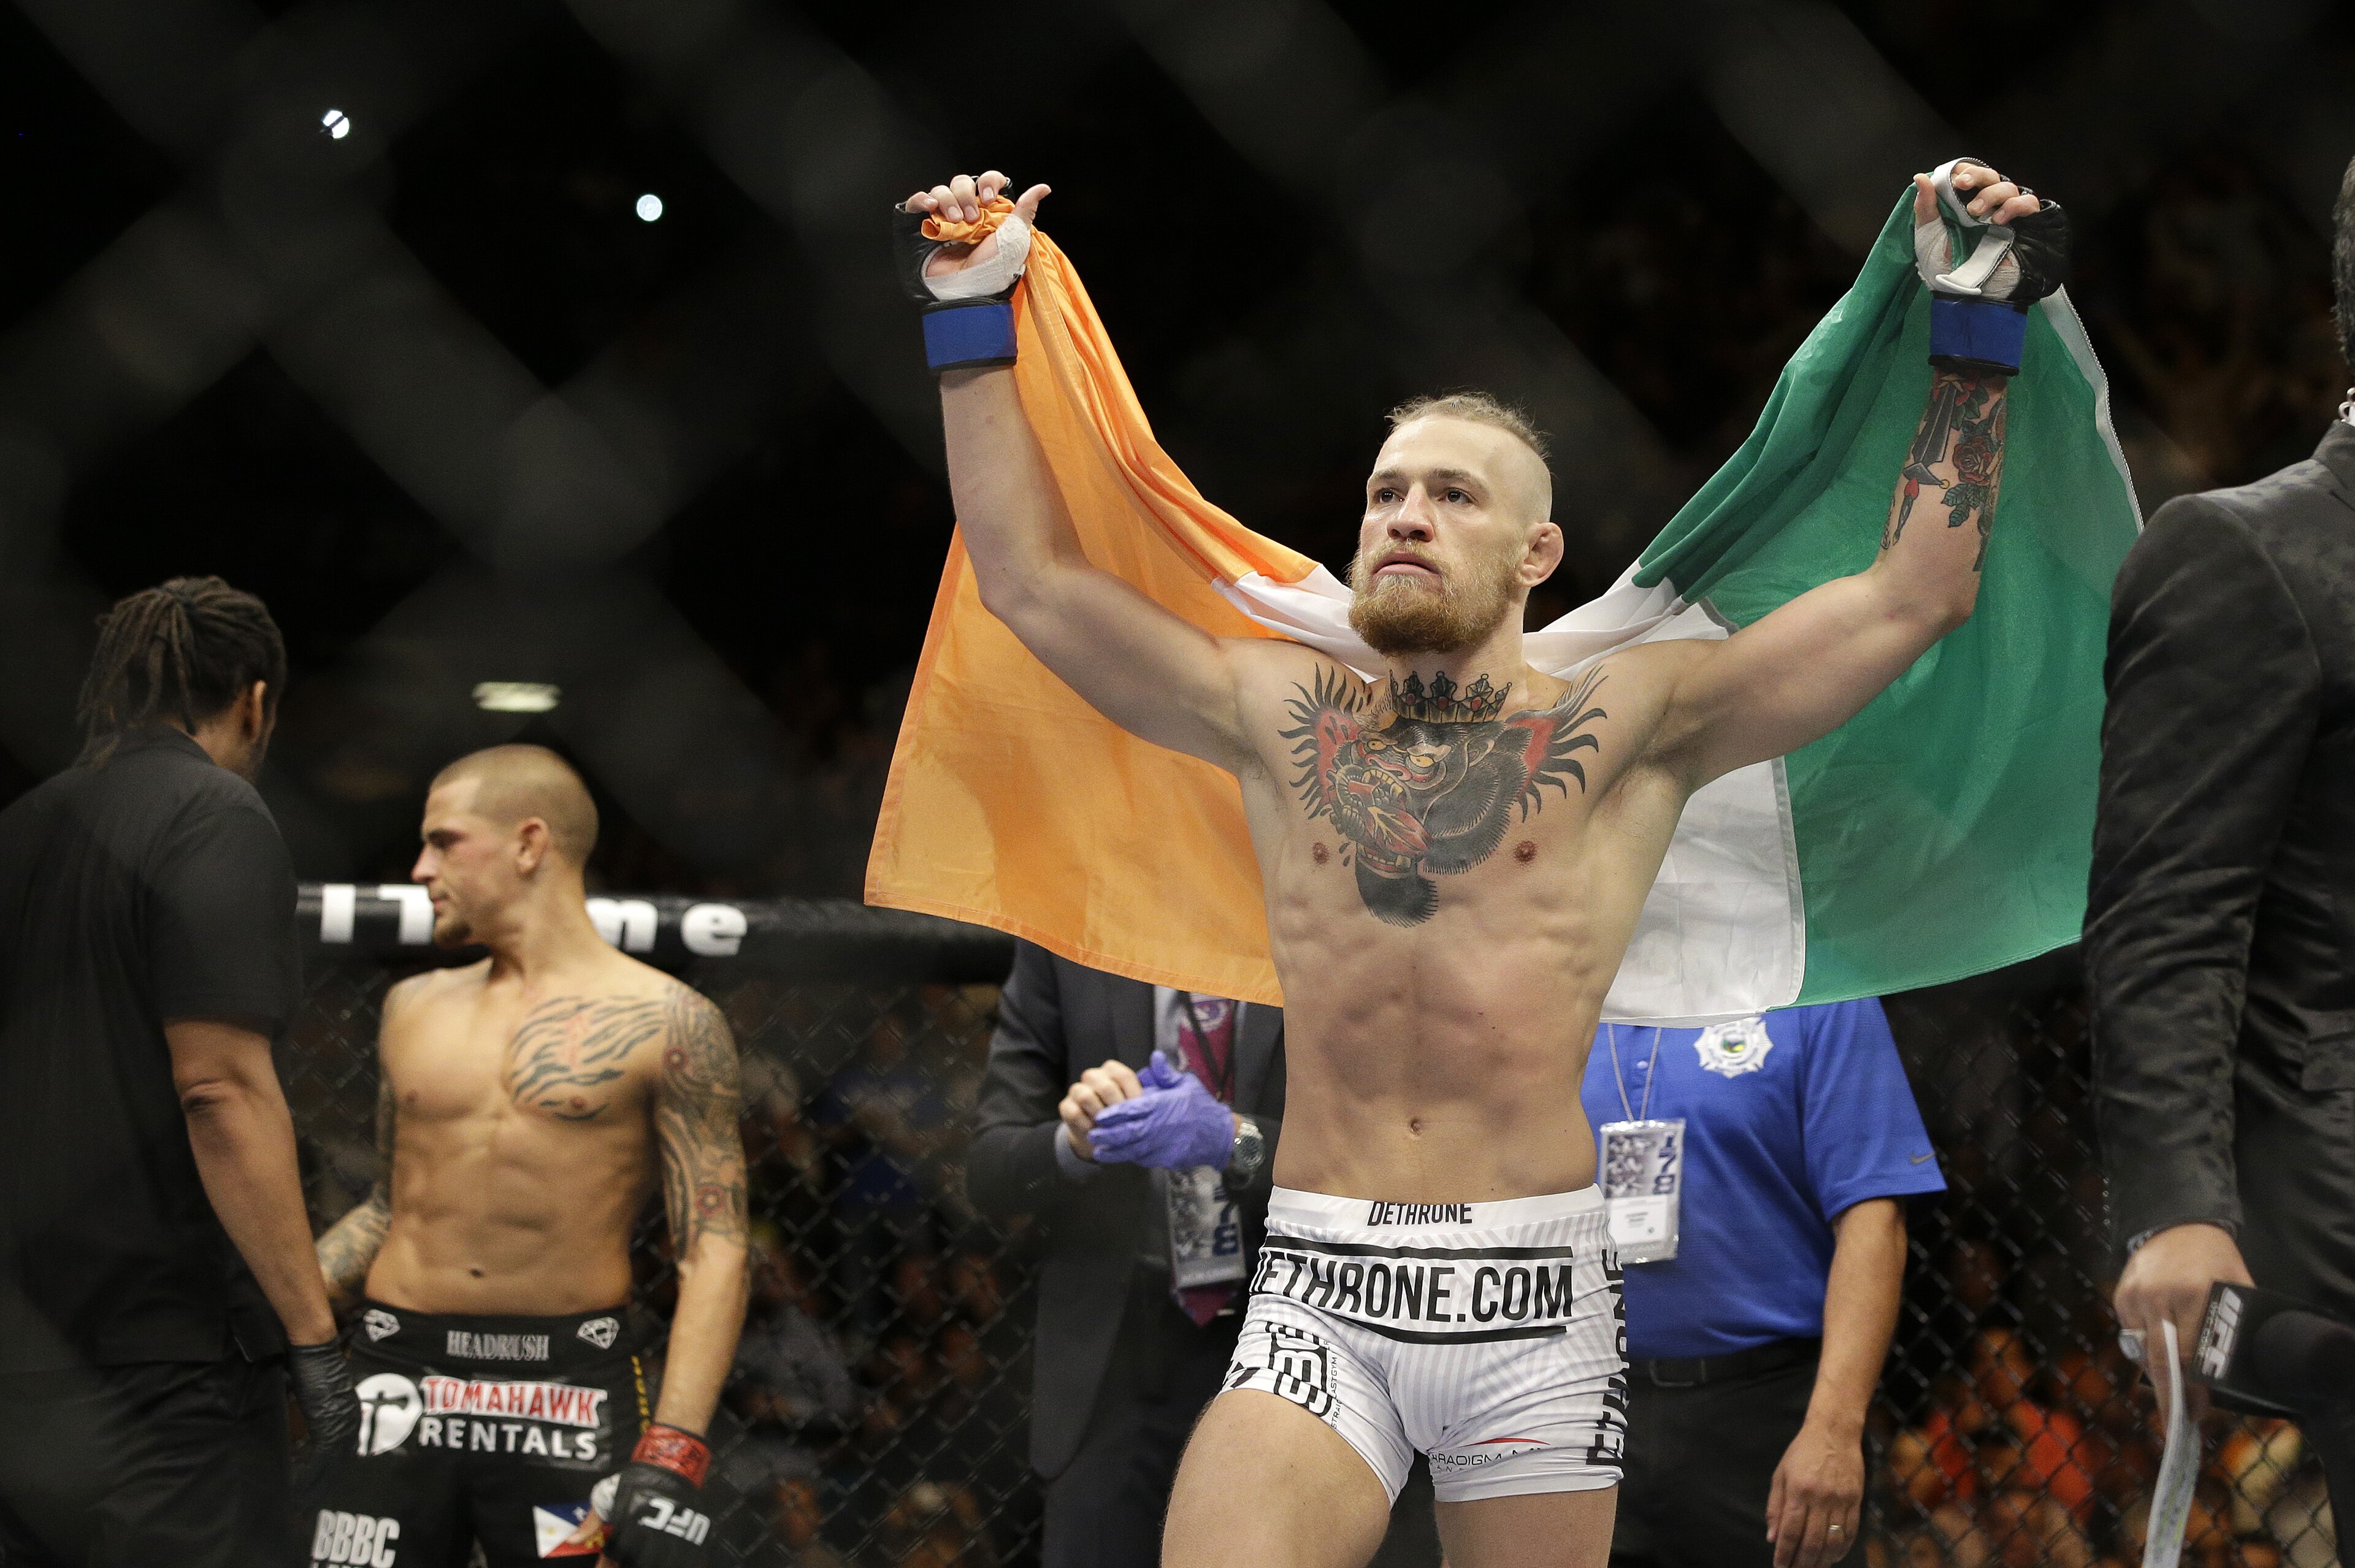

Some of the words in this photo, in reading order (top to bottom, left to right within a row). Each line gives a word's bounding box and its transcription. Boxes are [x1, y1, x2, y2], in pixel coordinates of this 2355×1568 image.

[1367, 1200, 1472, 1226] DETHRONE
[446, 1329, 550, 1361] HEADRUSH
[422, 1378, 596, 1424] TOMAHAWK
[418, 1416, 597, 1461] RENTALS
[312, 1509, 400, 1568] BBBC
[638, 1497, 710, 1547] UFC
